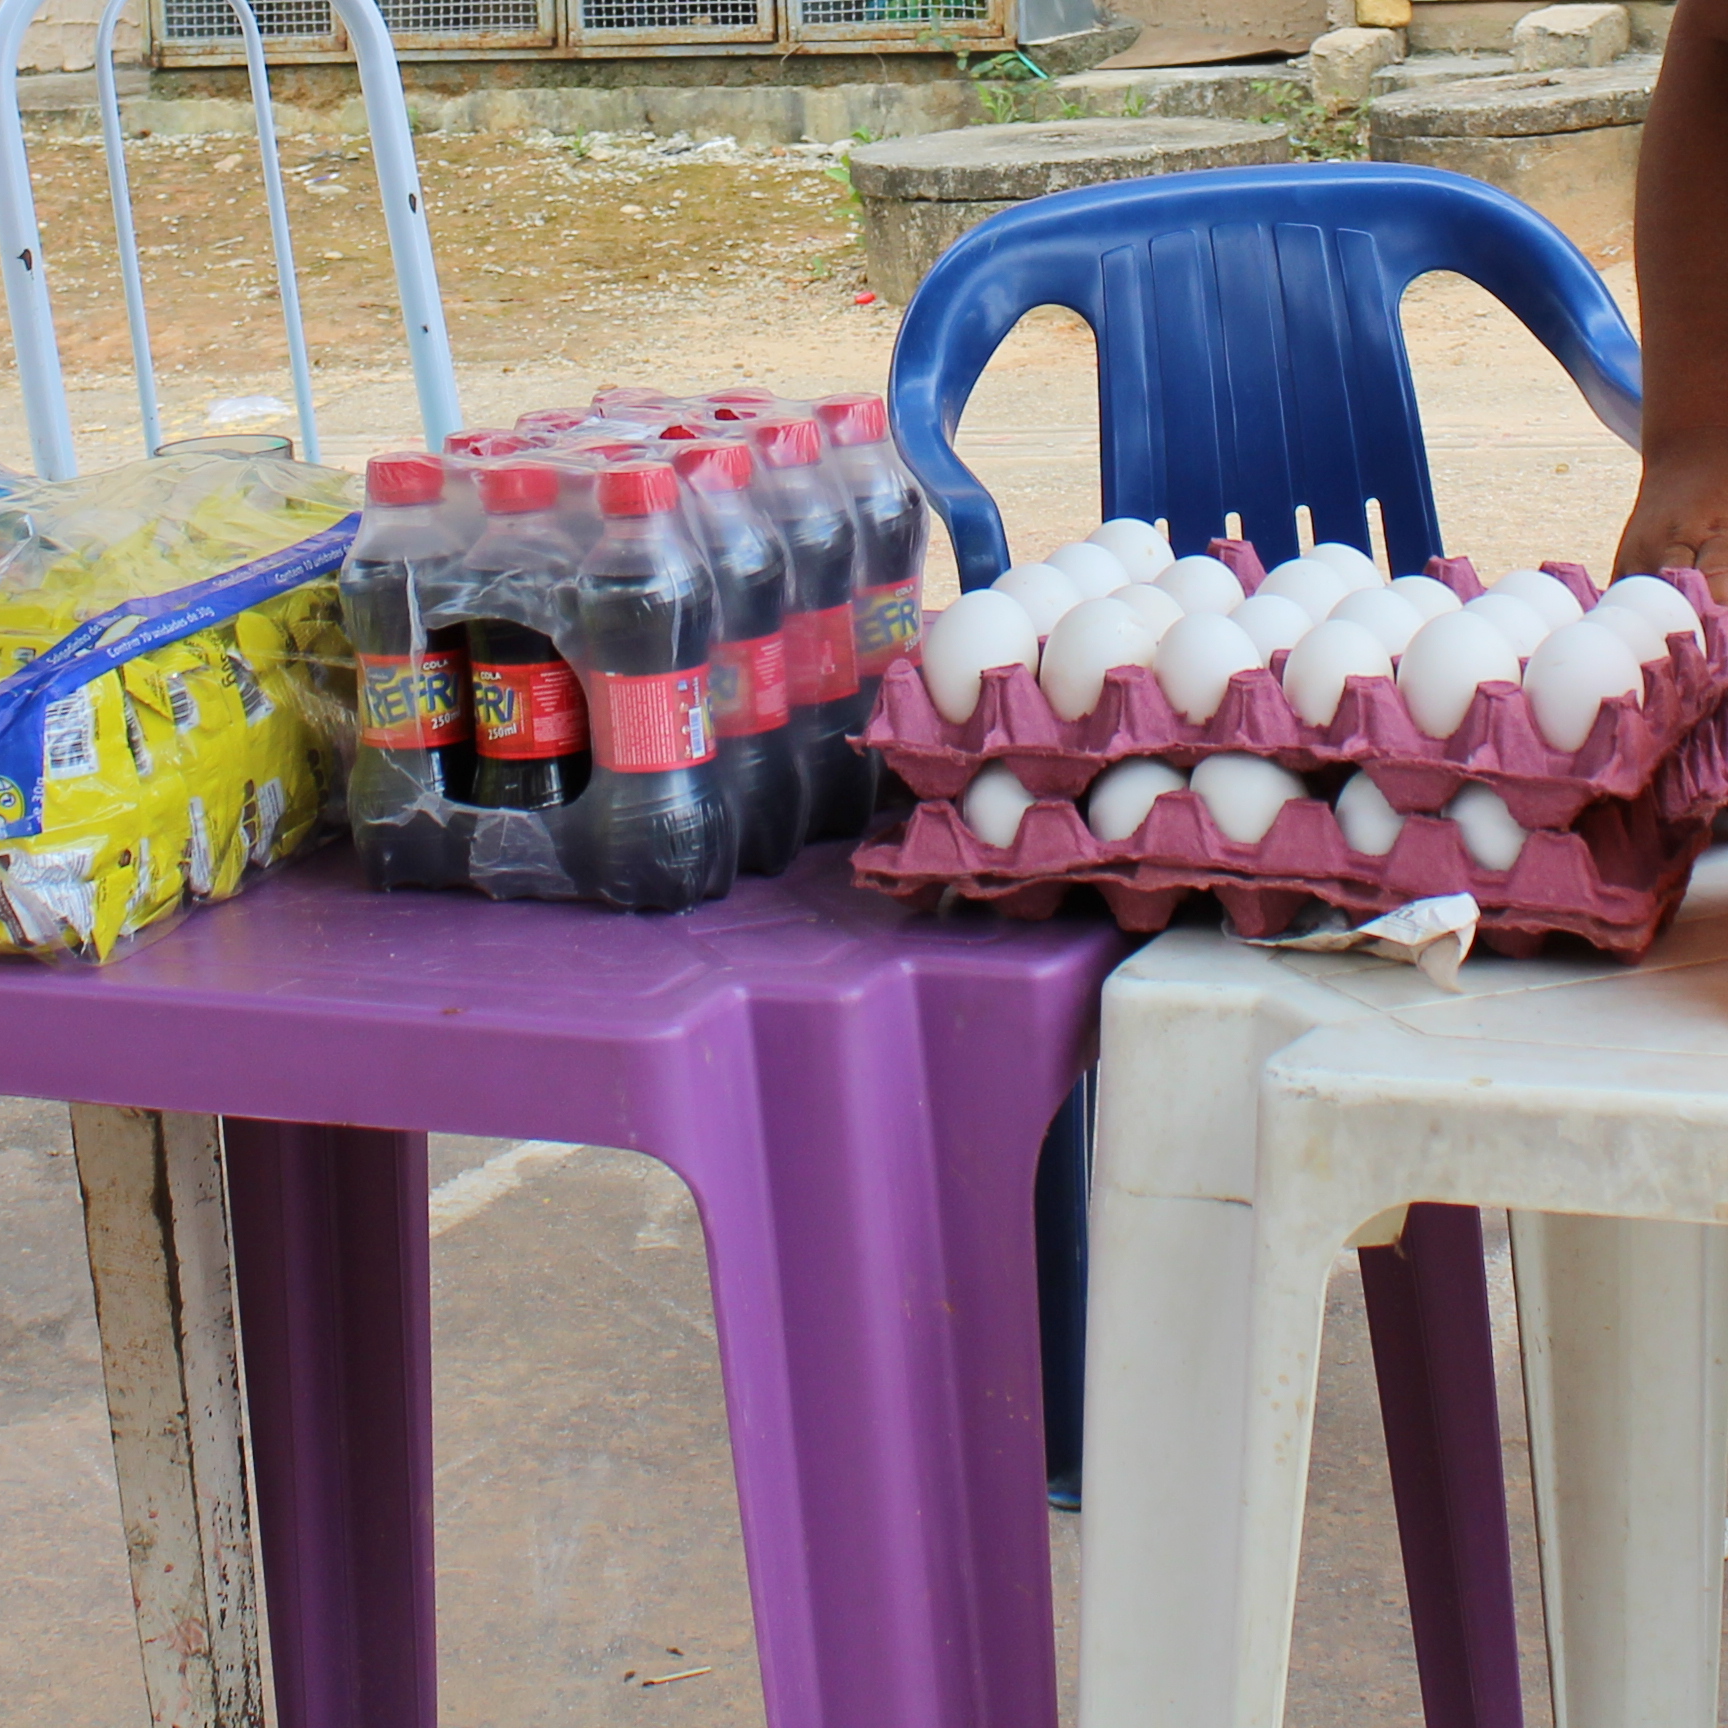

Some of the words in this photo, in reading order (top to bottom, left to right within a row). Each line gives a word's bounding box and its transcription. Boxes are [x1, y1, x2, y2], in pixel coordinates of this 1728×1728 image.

[422, 658, 450, 672] COLA
[480, 671, 502, 681] COLA
[364, 672, 460, 728] REFRI
[487, 723, 518, 741] 250ml
